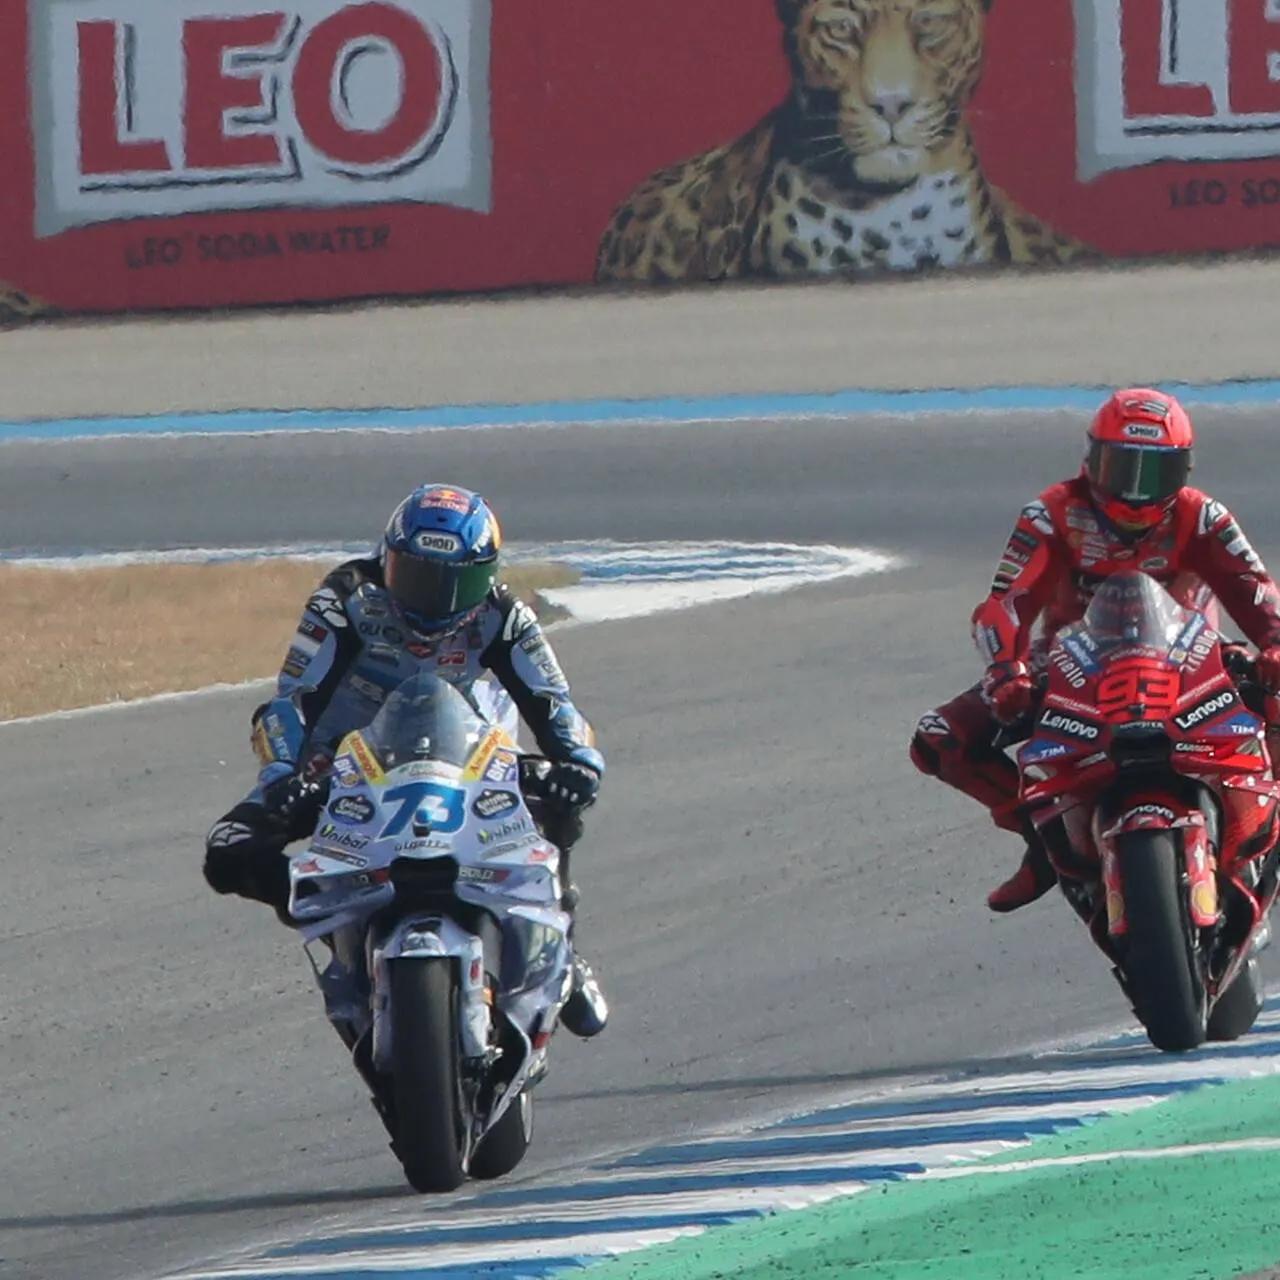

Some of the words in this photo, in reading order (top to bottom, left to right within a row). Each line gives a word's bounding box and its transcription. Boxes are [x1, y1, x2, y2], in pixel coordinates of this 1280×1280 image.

[77, 1, 455, 185] LEO
[1098, 667, 1182, 719] 93
[1175, 691, 1234, 729] Lenovo
[1040, 709, 1098, 740] Lenovo
[375, 781, 468, 841] 73
[320, 823, 369, 851] Unibat
